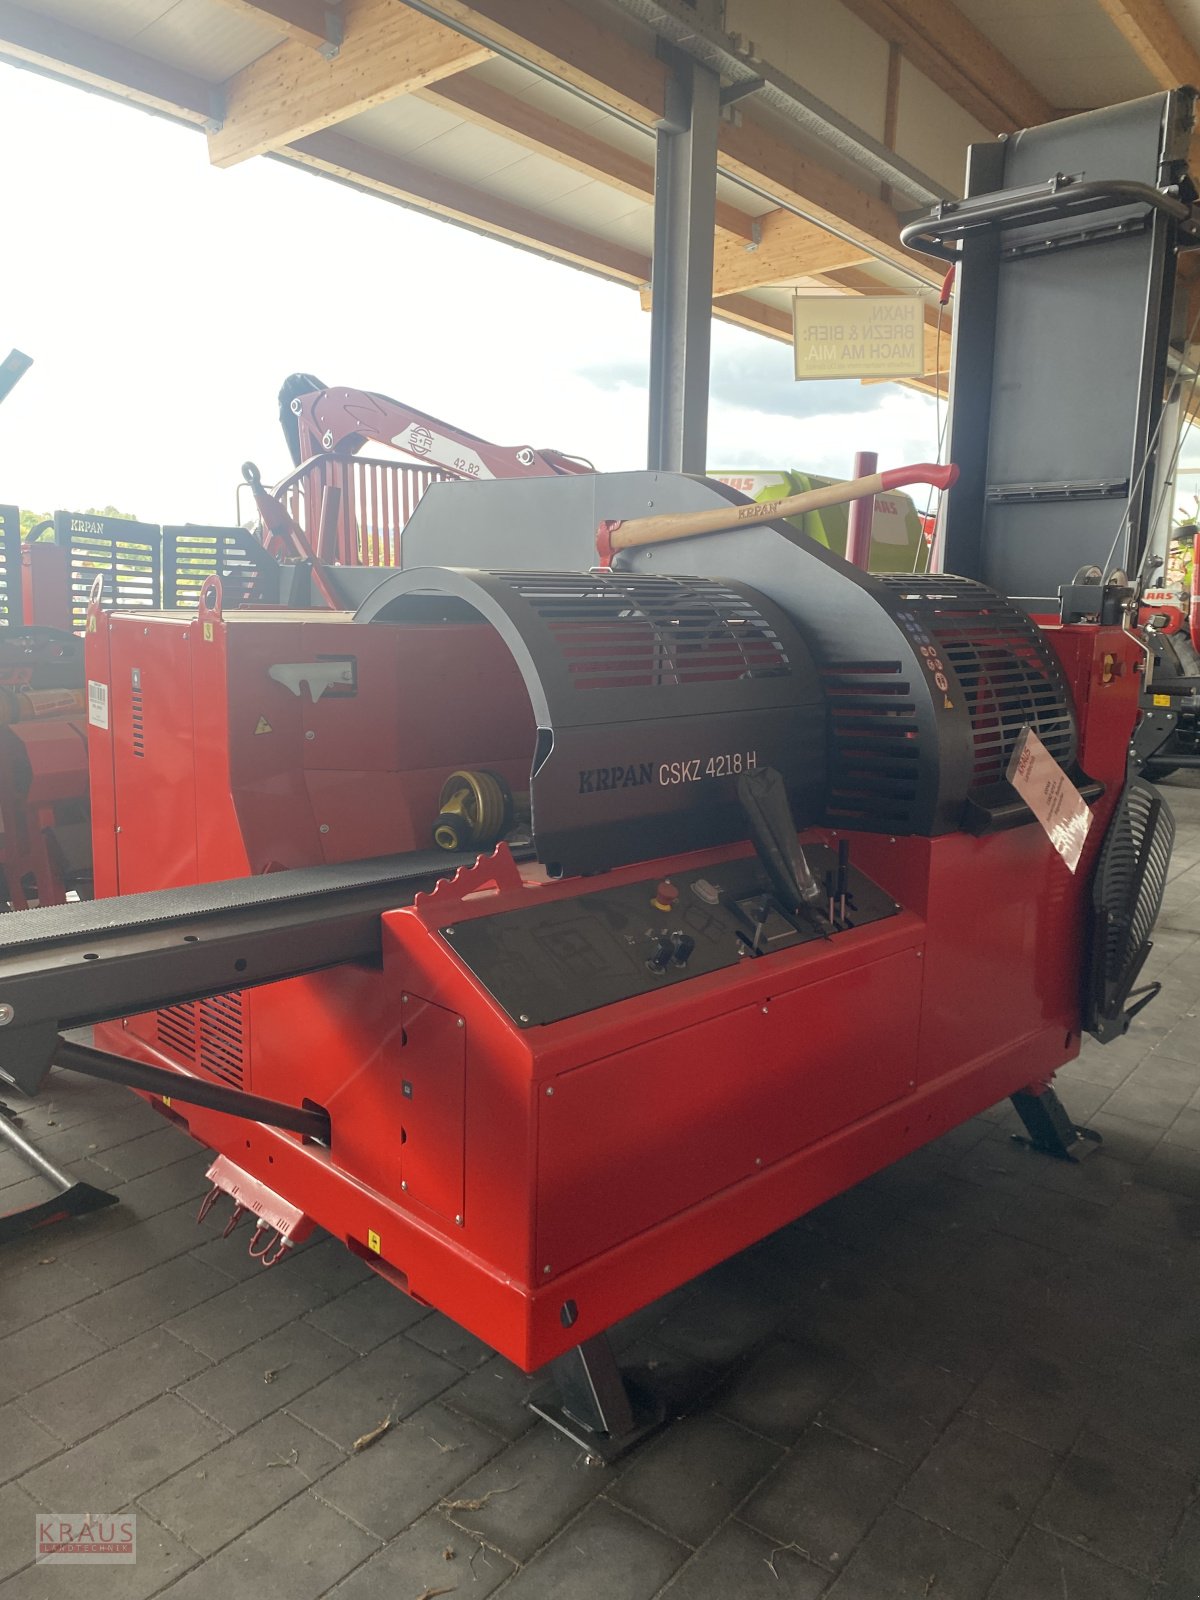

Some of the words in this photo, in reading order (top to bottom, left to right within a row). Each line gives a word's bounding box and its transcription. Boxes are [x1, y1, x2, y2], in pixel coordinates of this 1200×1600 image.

[453, 457, 480, 476] 42.82
[71, 519, 104, 534] KRPAN
[579, 763, 654, 793] KRPAN
[659, 759, 702, 786] CSKZ
[705, 753, 742, 778] 4218
[746, 750, 757, 770] H
